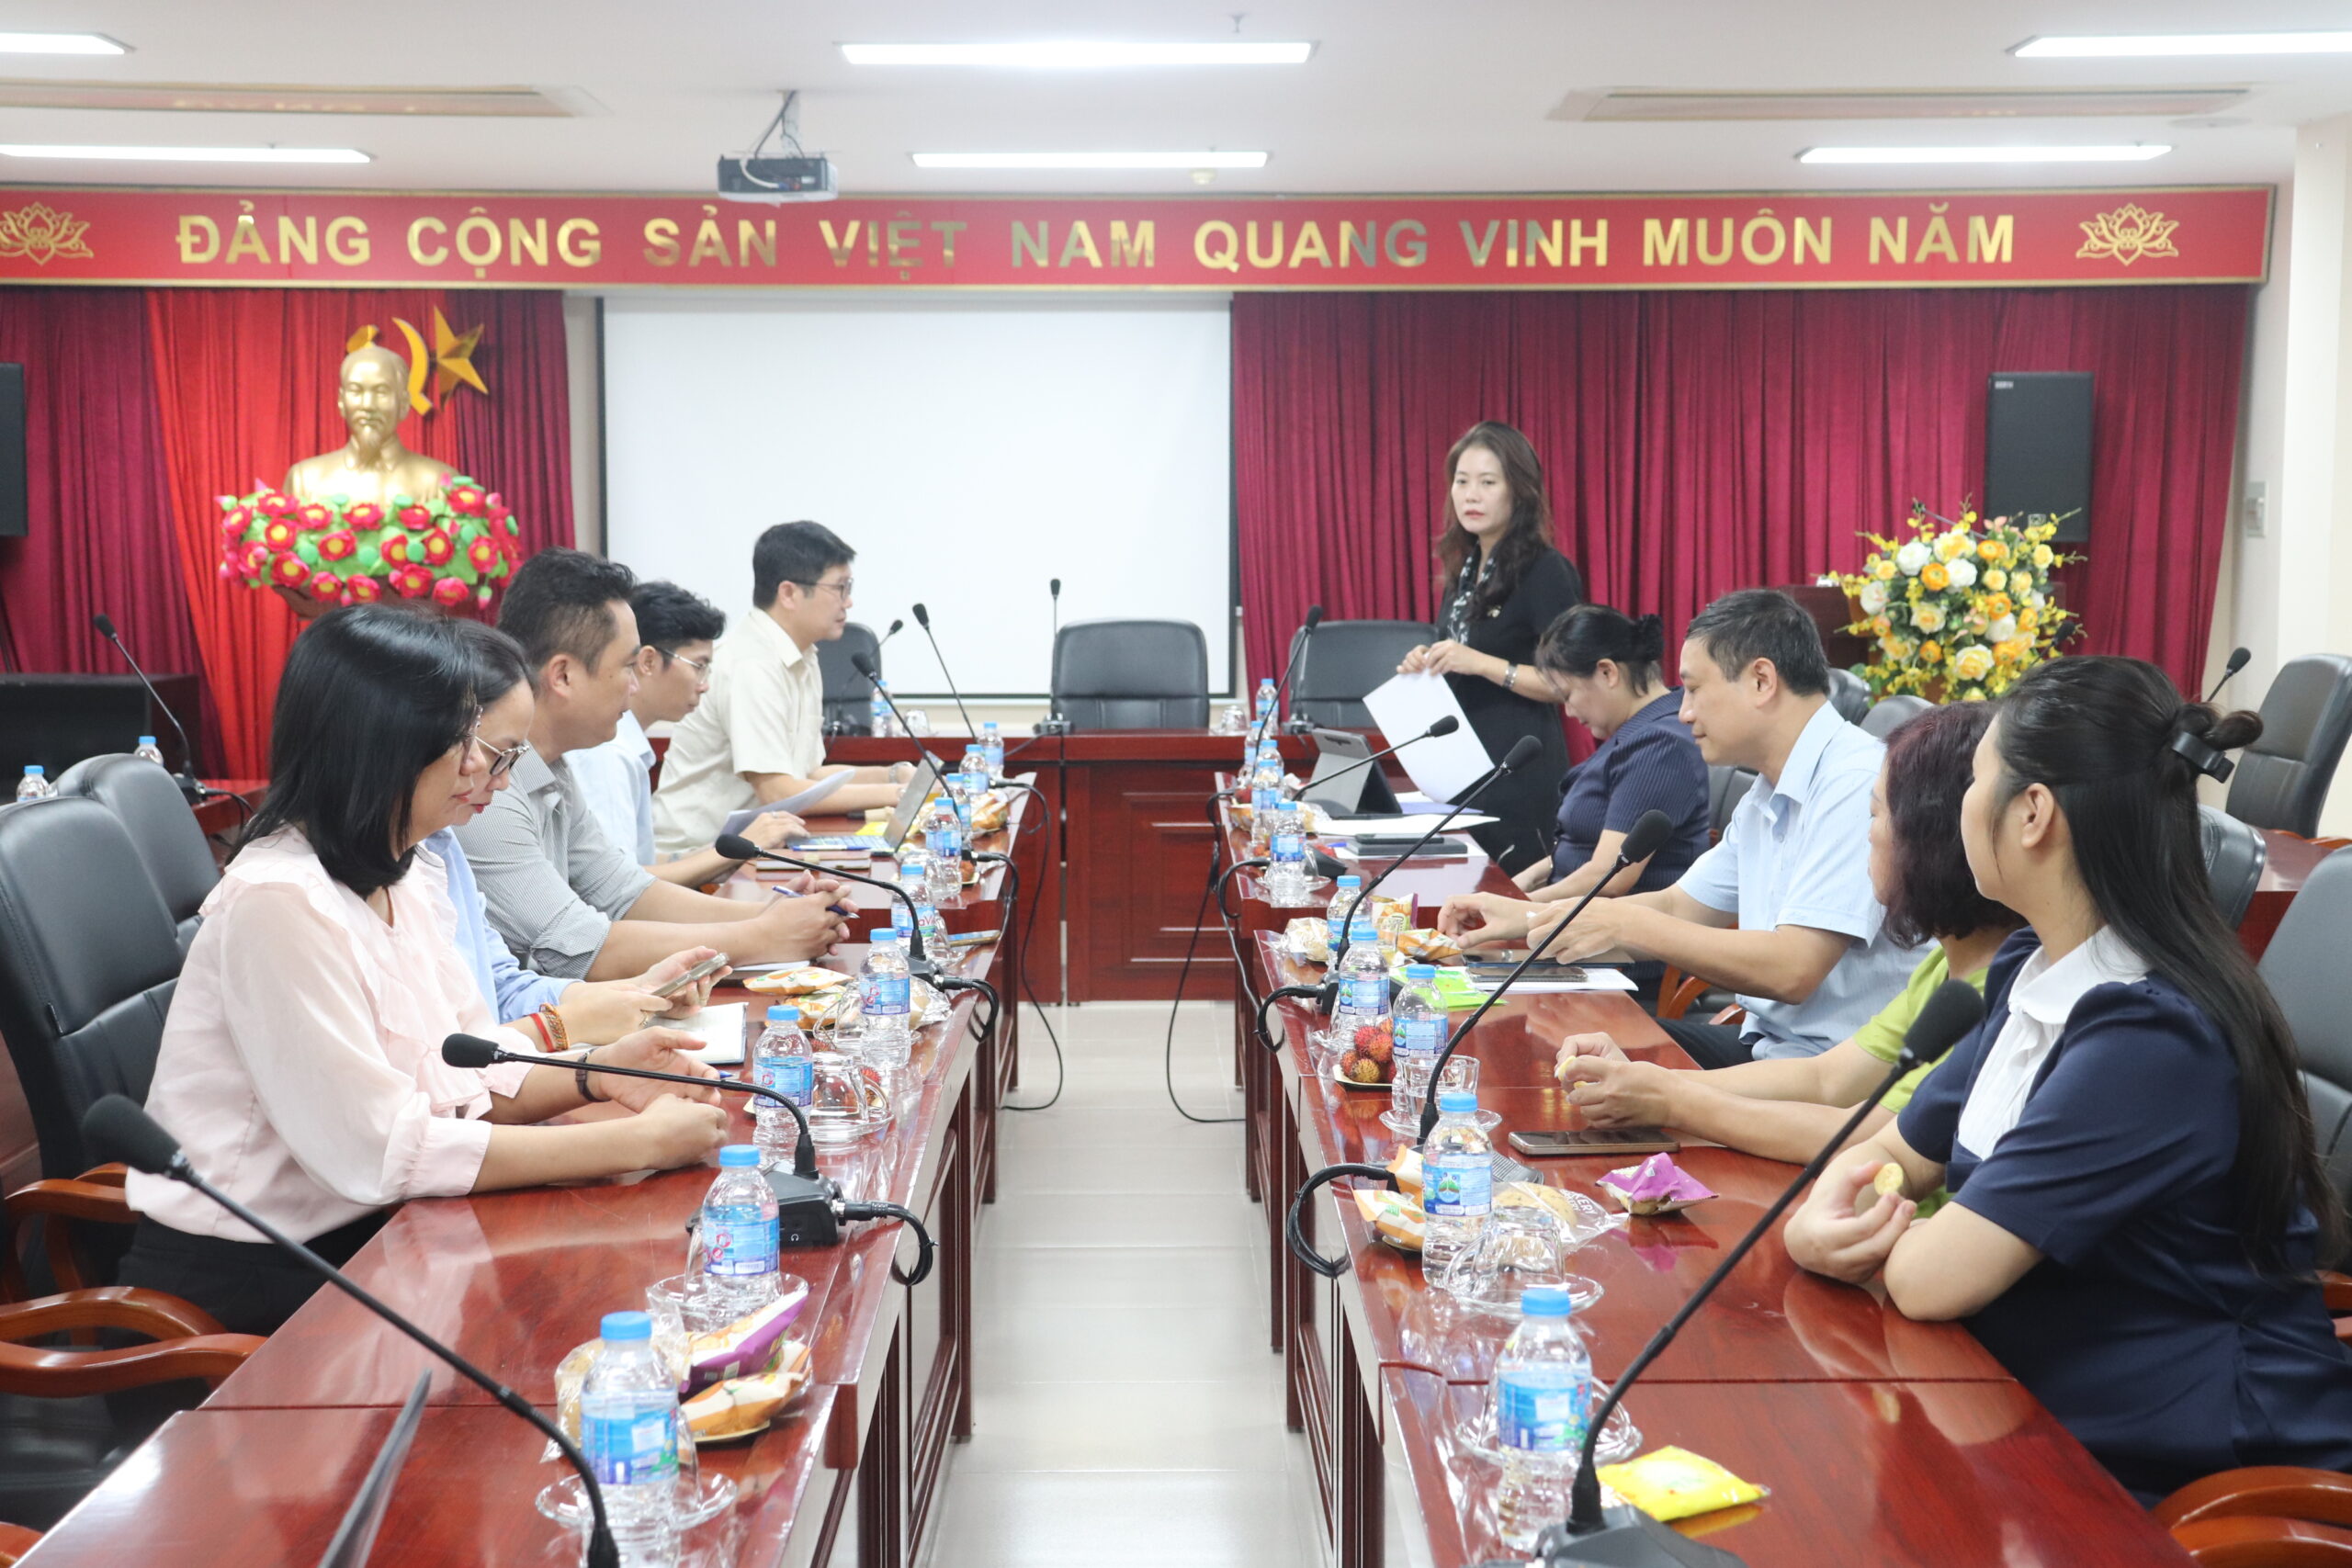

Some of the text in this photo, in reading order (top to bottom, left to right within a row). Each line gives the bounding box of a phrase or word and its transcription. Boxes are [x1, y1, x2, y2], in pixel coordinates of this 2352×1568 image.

[175, 199, 2014, 281] ĐẢNG CỘNG SẢN VIỆT NAM QUANG VINH MUÔN NĂM
